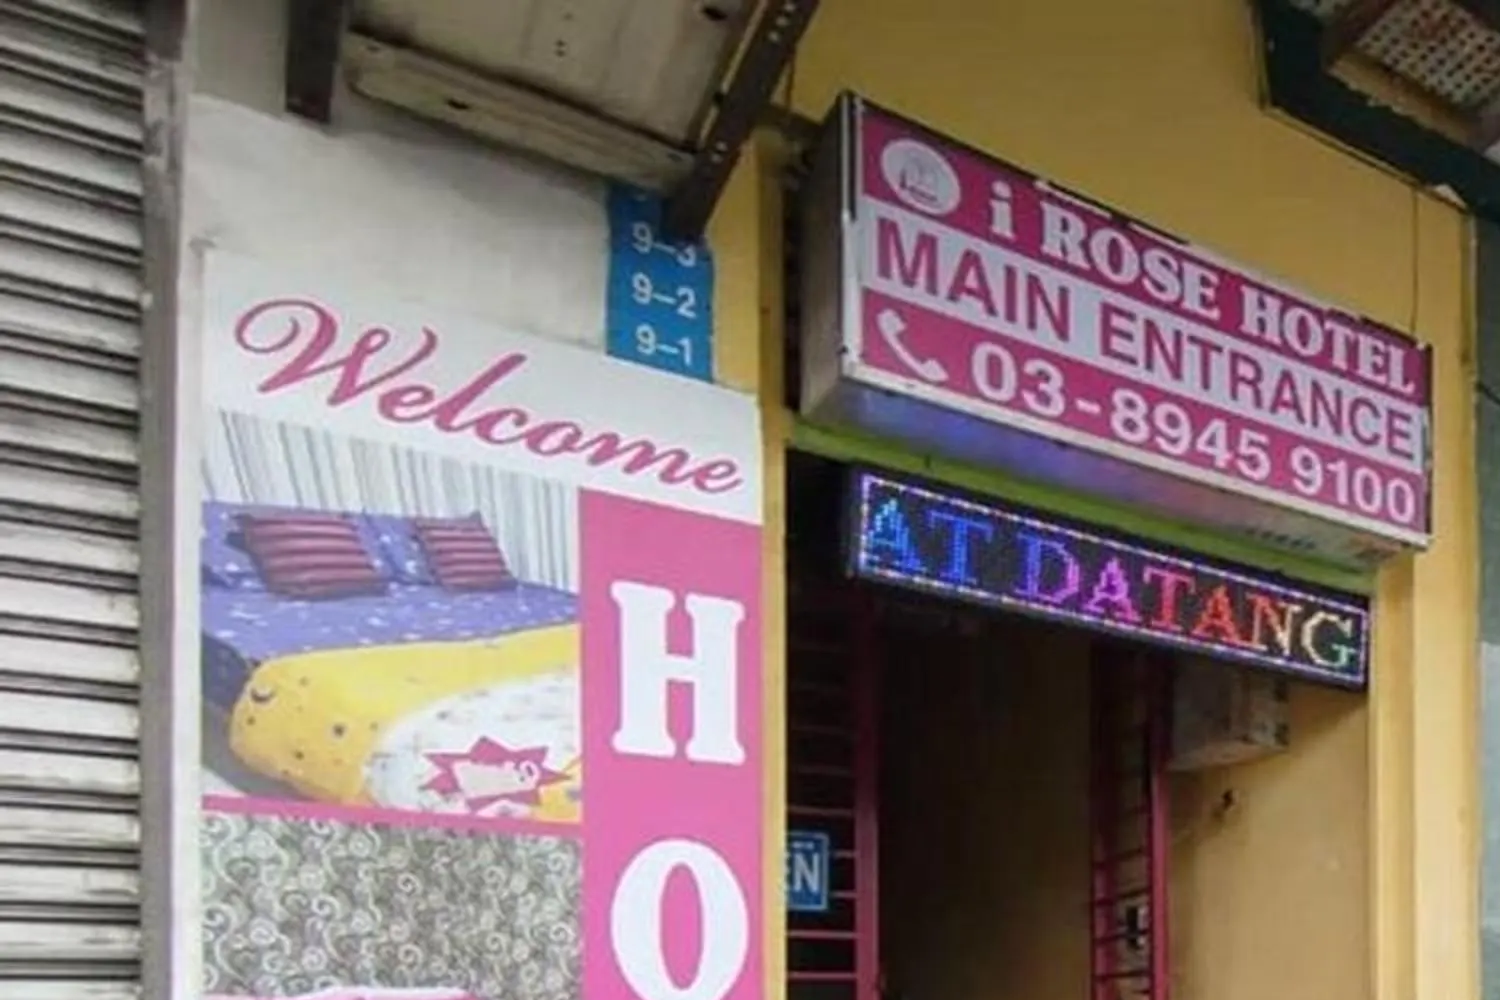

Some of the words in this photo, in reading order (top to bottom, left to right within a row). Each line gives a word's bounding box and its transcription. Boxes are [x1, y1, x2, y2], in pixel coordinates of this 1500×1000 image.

[632, 271, 697, 320] 9-2
[635, 323, 693, 367] 9-1
[875, 215, 1072, 345] MAIN
[1100, 307, 1418, 463] ENTRANCE
[988, 180, 1016, 241] i
[1040, 199, 1222, 321] ROSE
[1240, 283, 1415, 396] HOTEL
[234, 298, 744, 494] Welcome
[1290, 444, 1417, 524] 9100
[1014, 530, 1358, 671] DATANG
